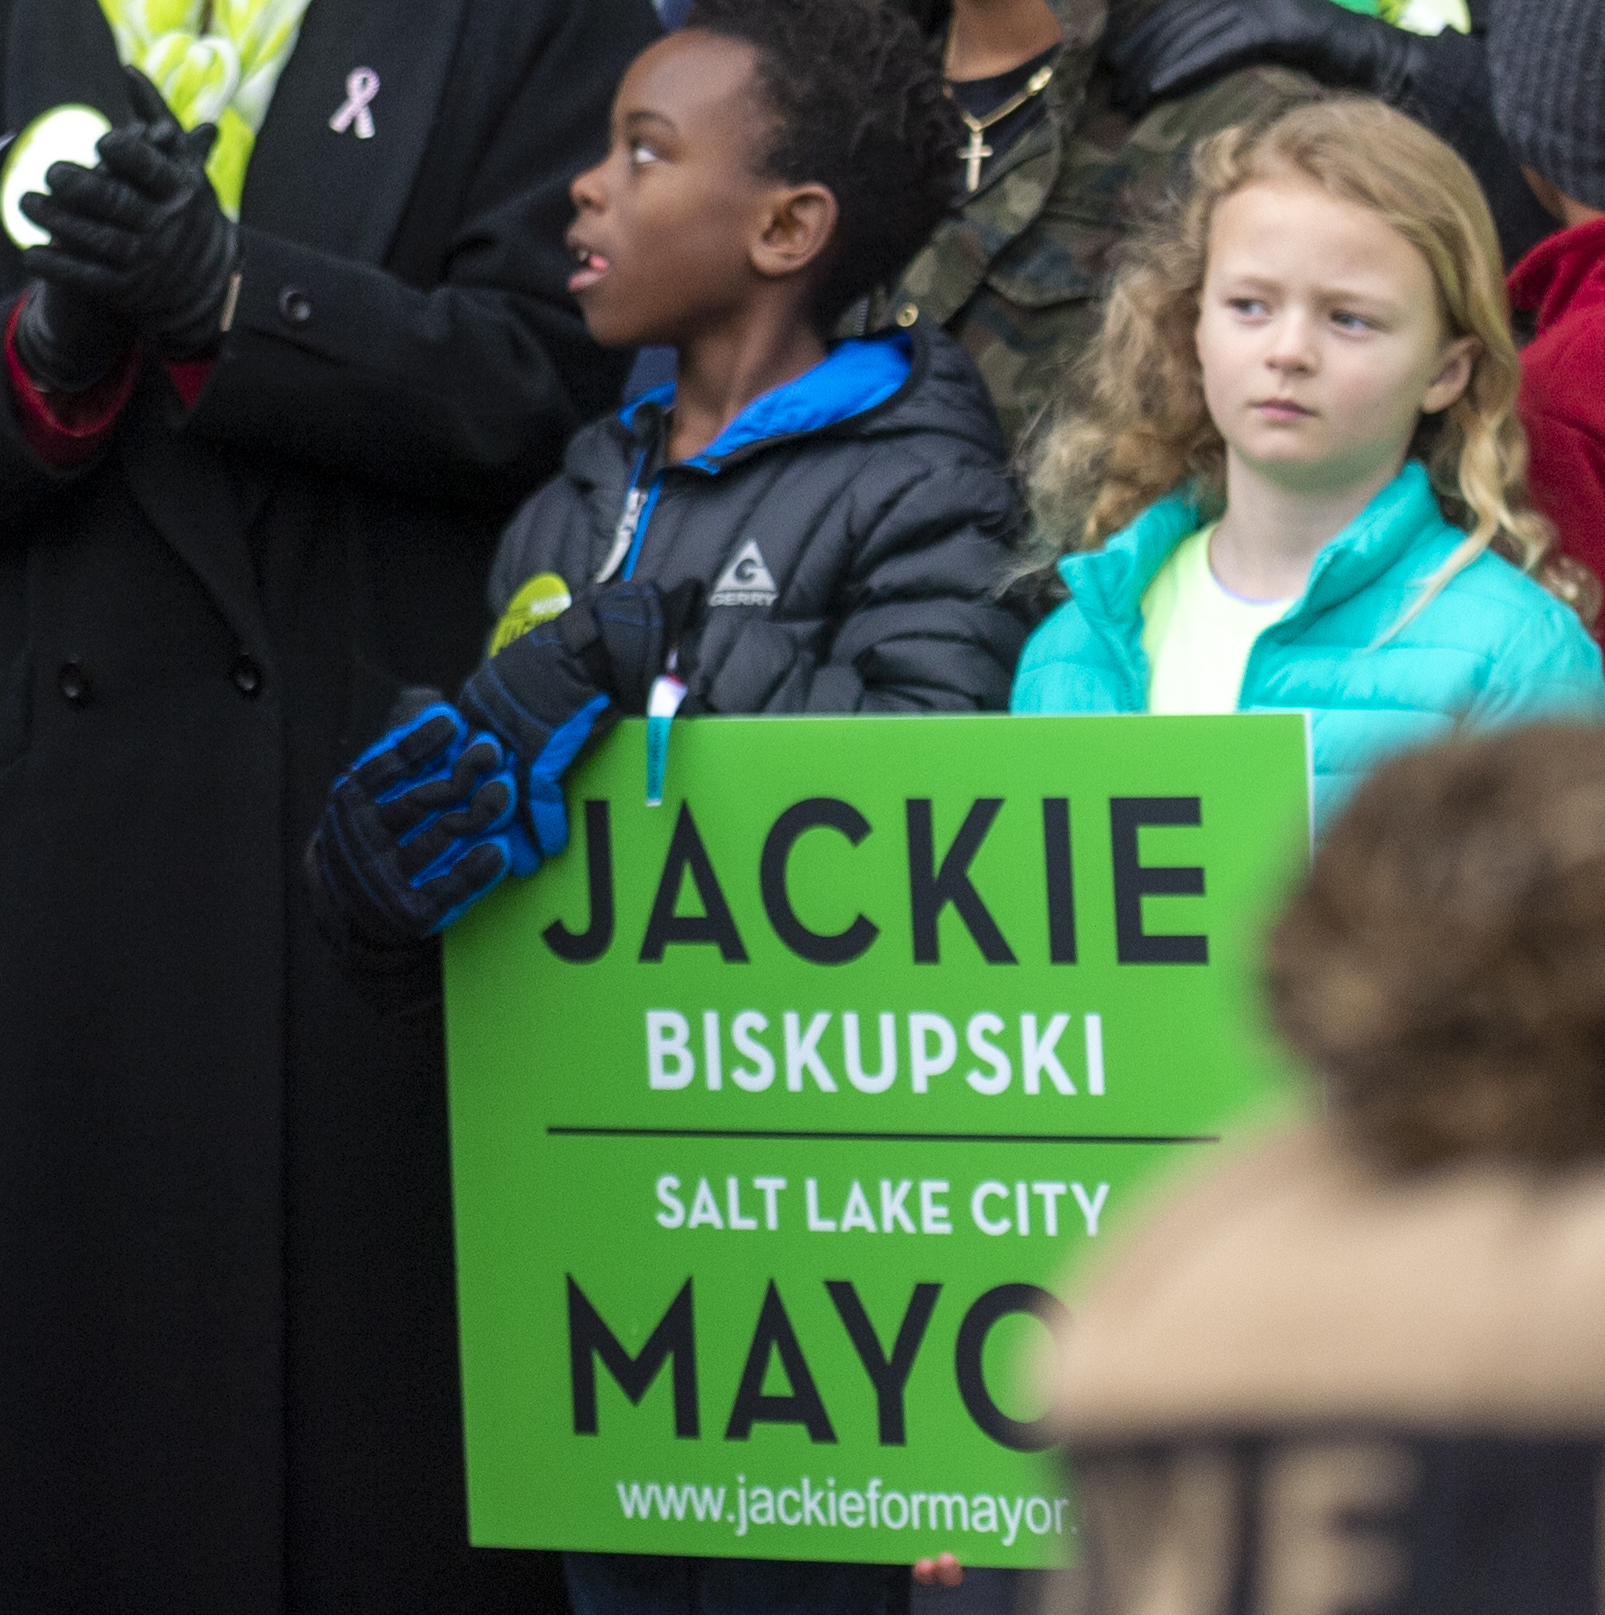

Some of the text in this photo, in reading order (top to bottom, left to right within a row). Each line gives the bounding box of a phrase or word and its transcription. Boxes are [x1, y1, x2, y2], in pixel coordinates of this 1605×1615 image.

[541, 796, 1210, 967] JACKIE
[646, 1010, 1105, 1096] BISKUPSKI
[655, 1175, 1111, 1238] SALT LAKE CITY
[565, 1273, 1073, 1453] MAYO
[617, 1475, 1079, 1547] www.jackieformayor.
